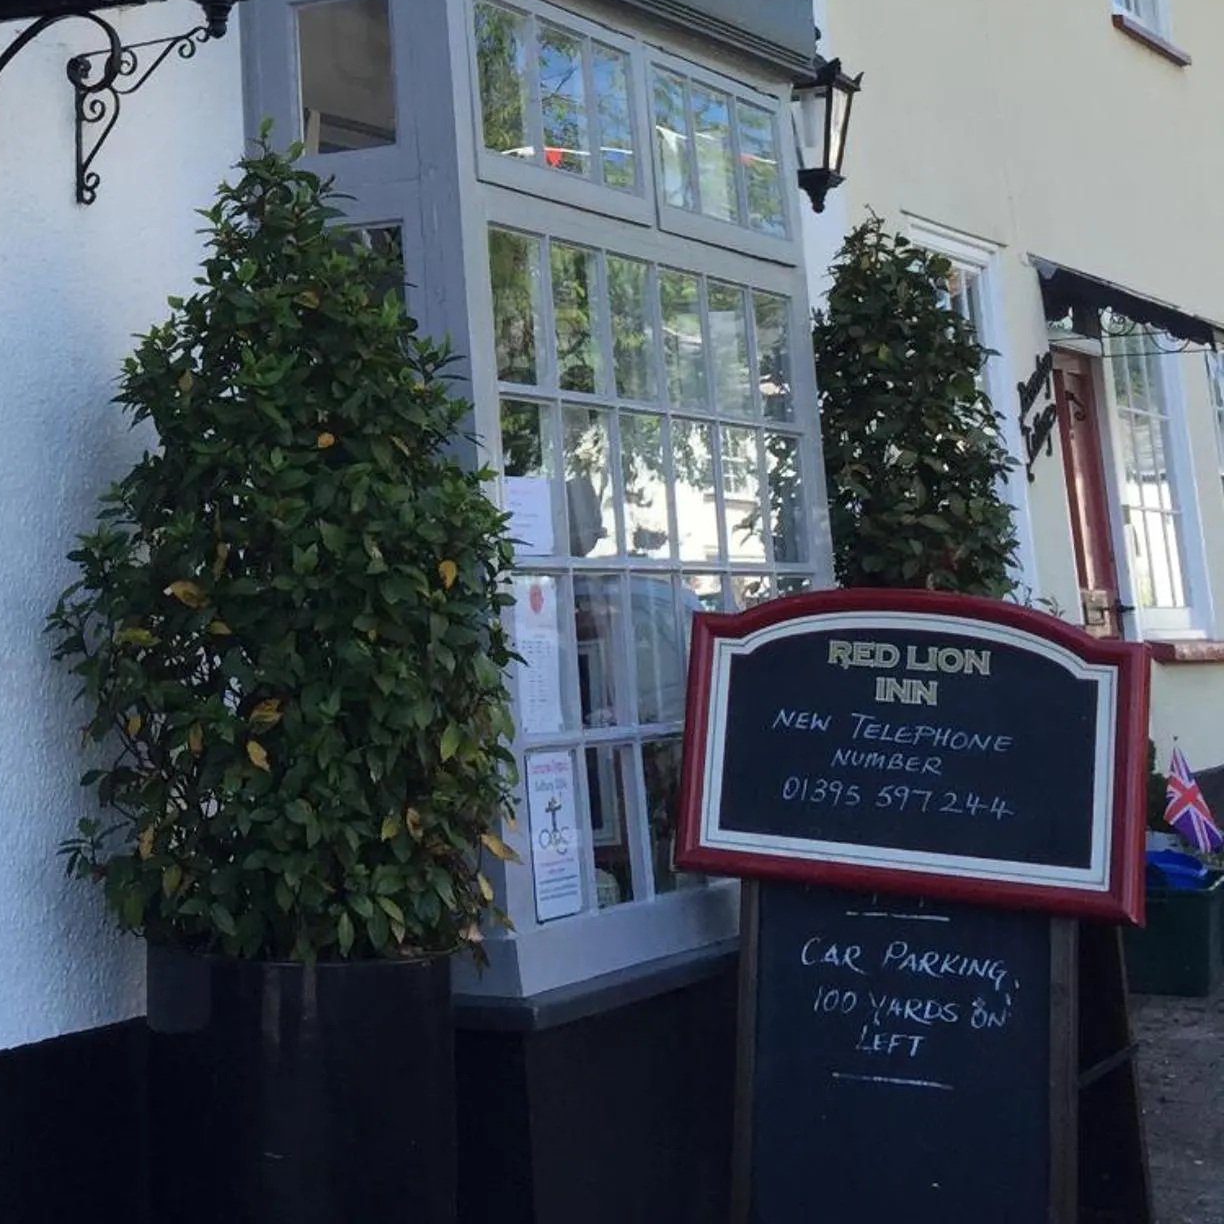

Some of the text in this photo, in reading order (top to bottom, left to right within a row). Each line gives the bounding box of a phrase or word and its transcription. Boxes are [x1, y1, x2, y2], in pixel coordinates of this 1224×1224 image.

[827, 639, 991, 676] RED LION
[875, 676, 938, 707] INN
[772, 708, 1015, 753] NEW TELEPHONE
[831, 747, 943, 776] NUMBER
[782, 776, 861, 806] 01395
[800, 936, 869, 976] CAR
[813, 986, 1007, 1029] 100 YARDS ON
[856, 1025, 925, 1057] LEFT
